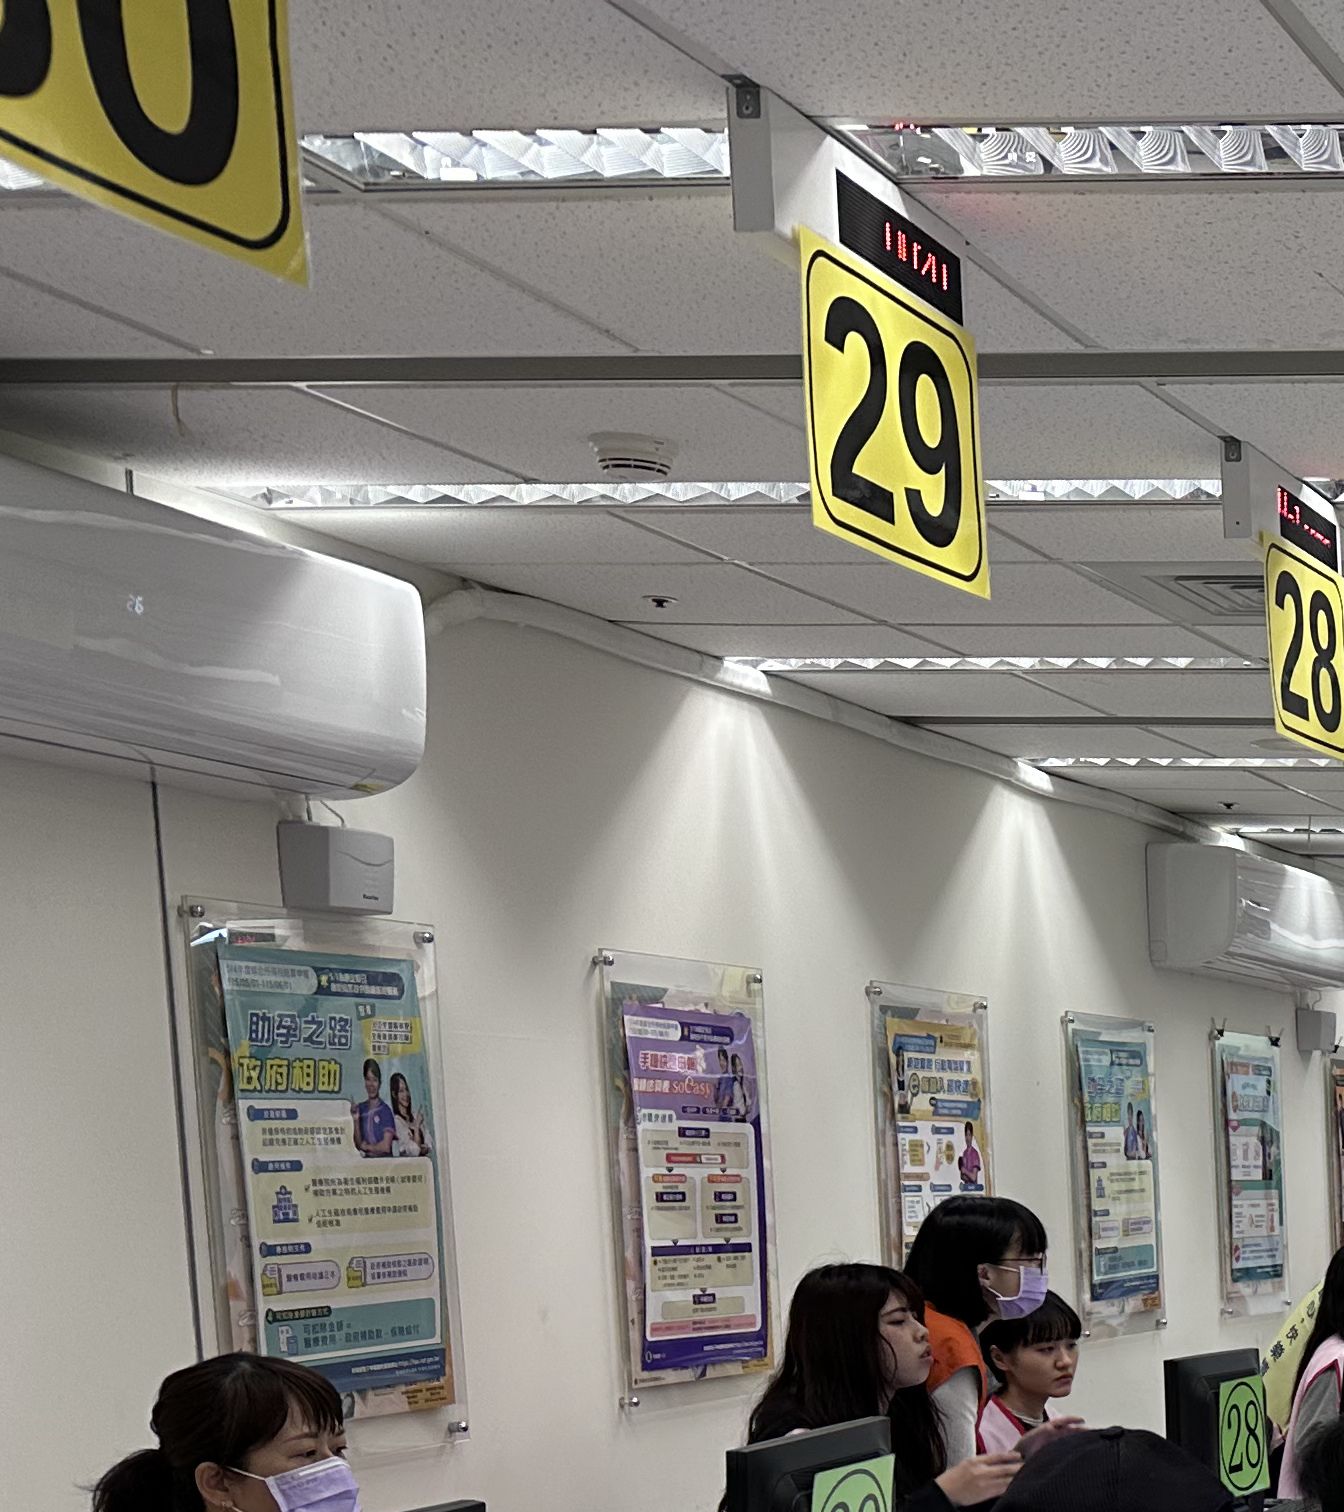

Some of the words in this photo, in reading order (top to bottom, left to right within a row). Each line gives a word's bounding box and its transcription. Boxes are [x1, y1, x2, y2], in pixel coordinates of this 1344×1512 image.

[823, 296, 961, 550] 29
[1275, 570, 1342, 733] 28
[248, 1010, 353, 1050] 助孕之路
[238, 1056, 343, 1093] 政府相助
[1227, 1400, 1261, 1473] 28
